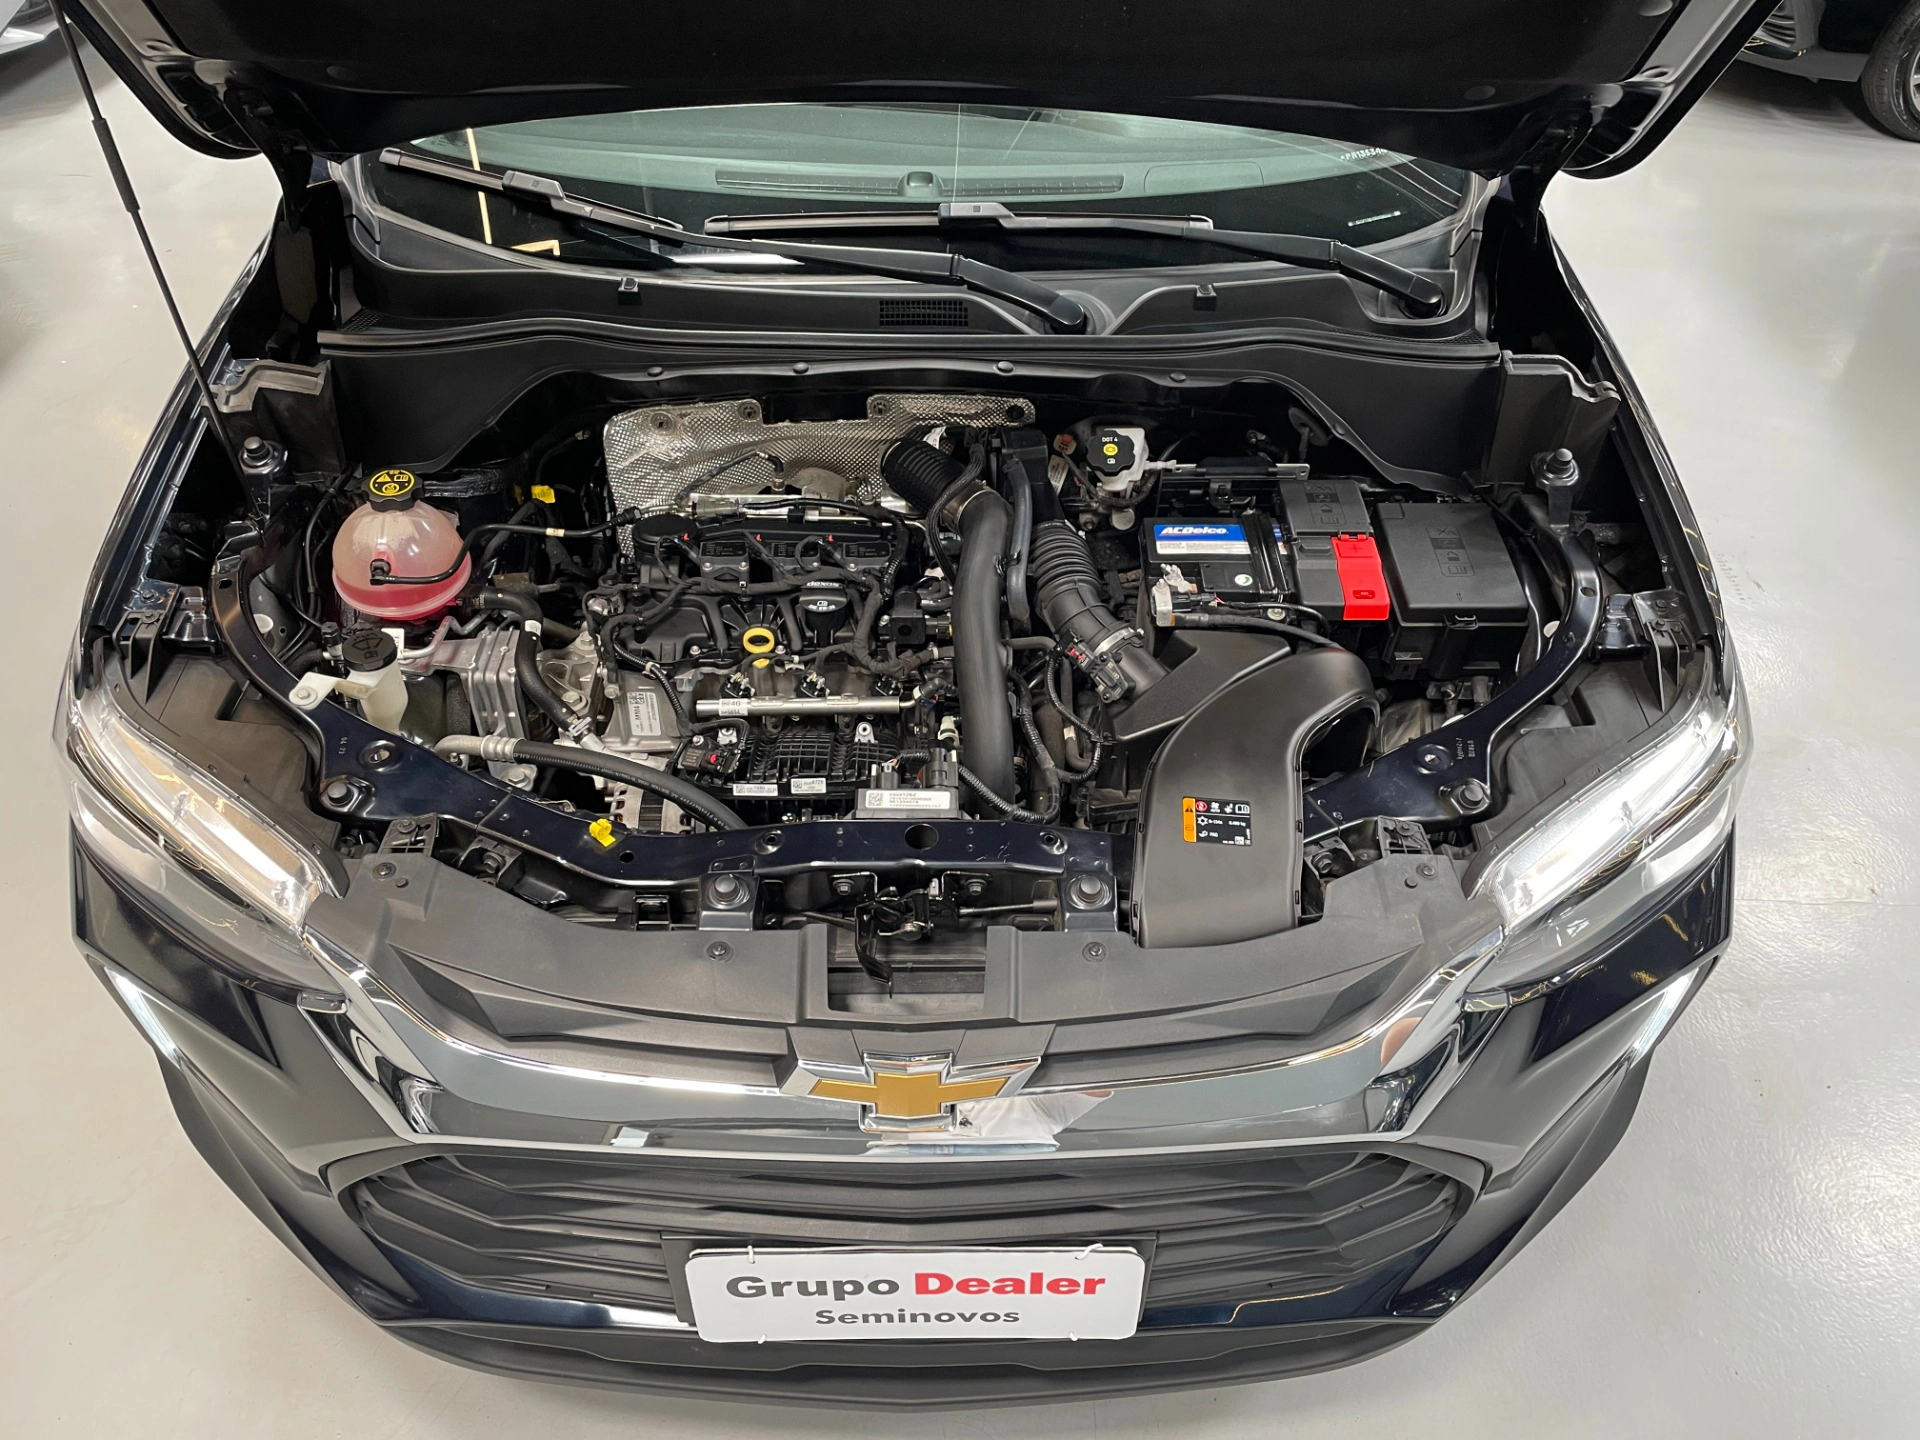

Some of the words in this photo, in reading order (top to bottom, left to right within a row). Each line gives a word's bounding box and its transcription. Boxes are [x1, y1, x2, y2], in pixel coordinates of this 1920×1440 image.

[1160, 526, 1228, 535] ACDelco
[726, 1275, 899, 1302] Grupo
[915, 1272, 1107, 1296] Dealer
[815, 1309, 1020, 1325] Seminovos
